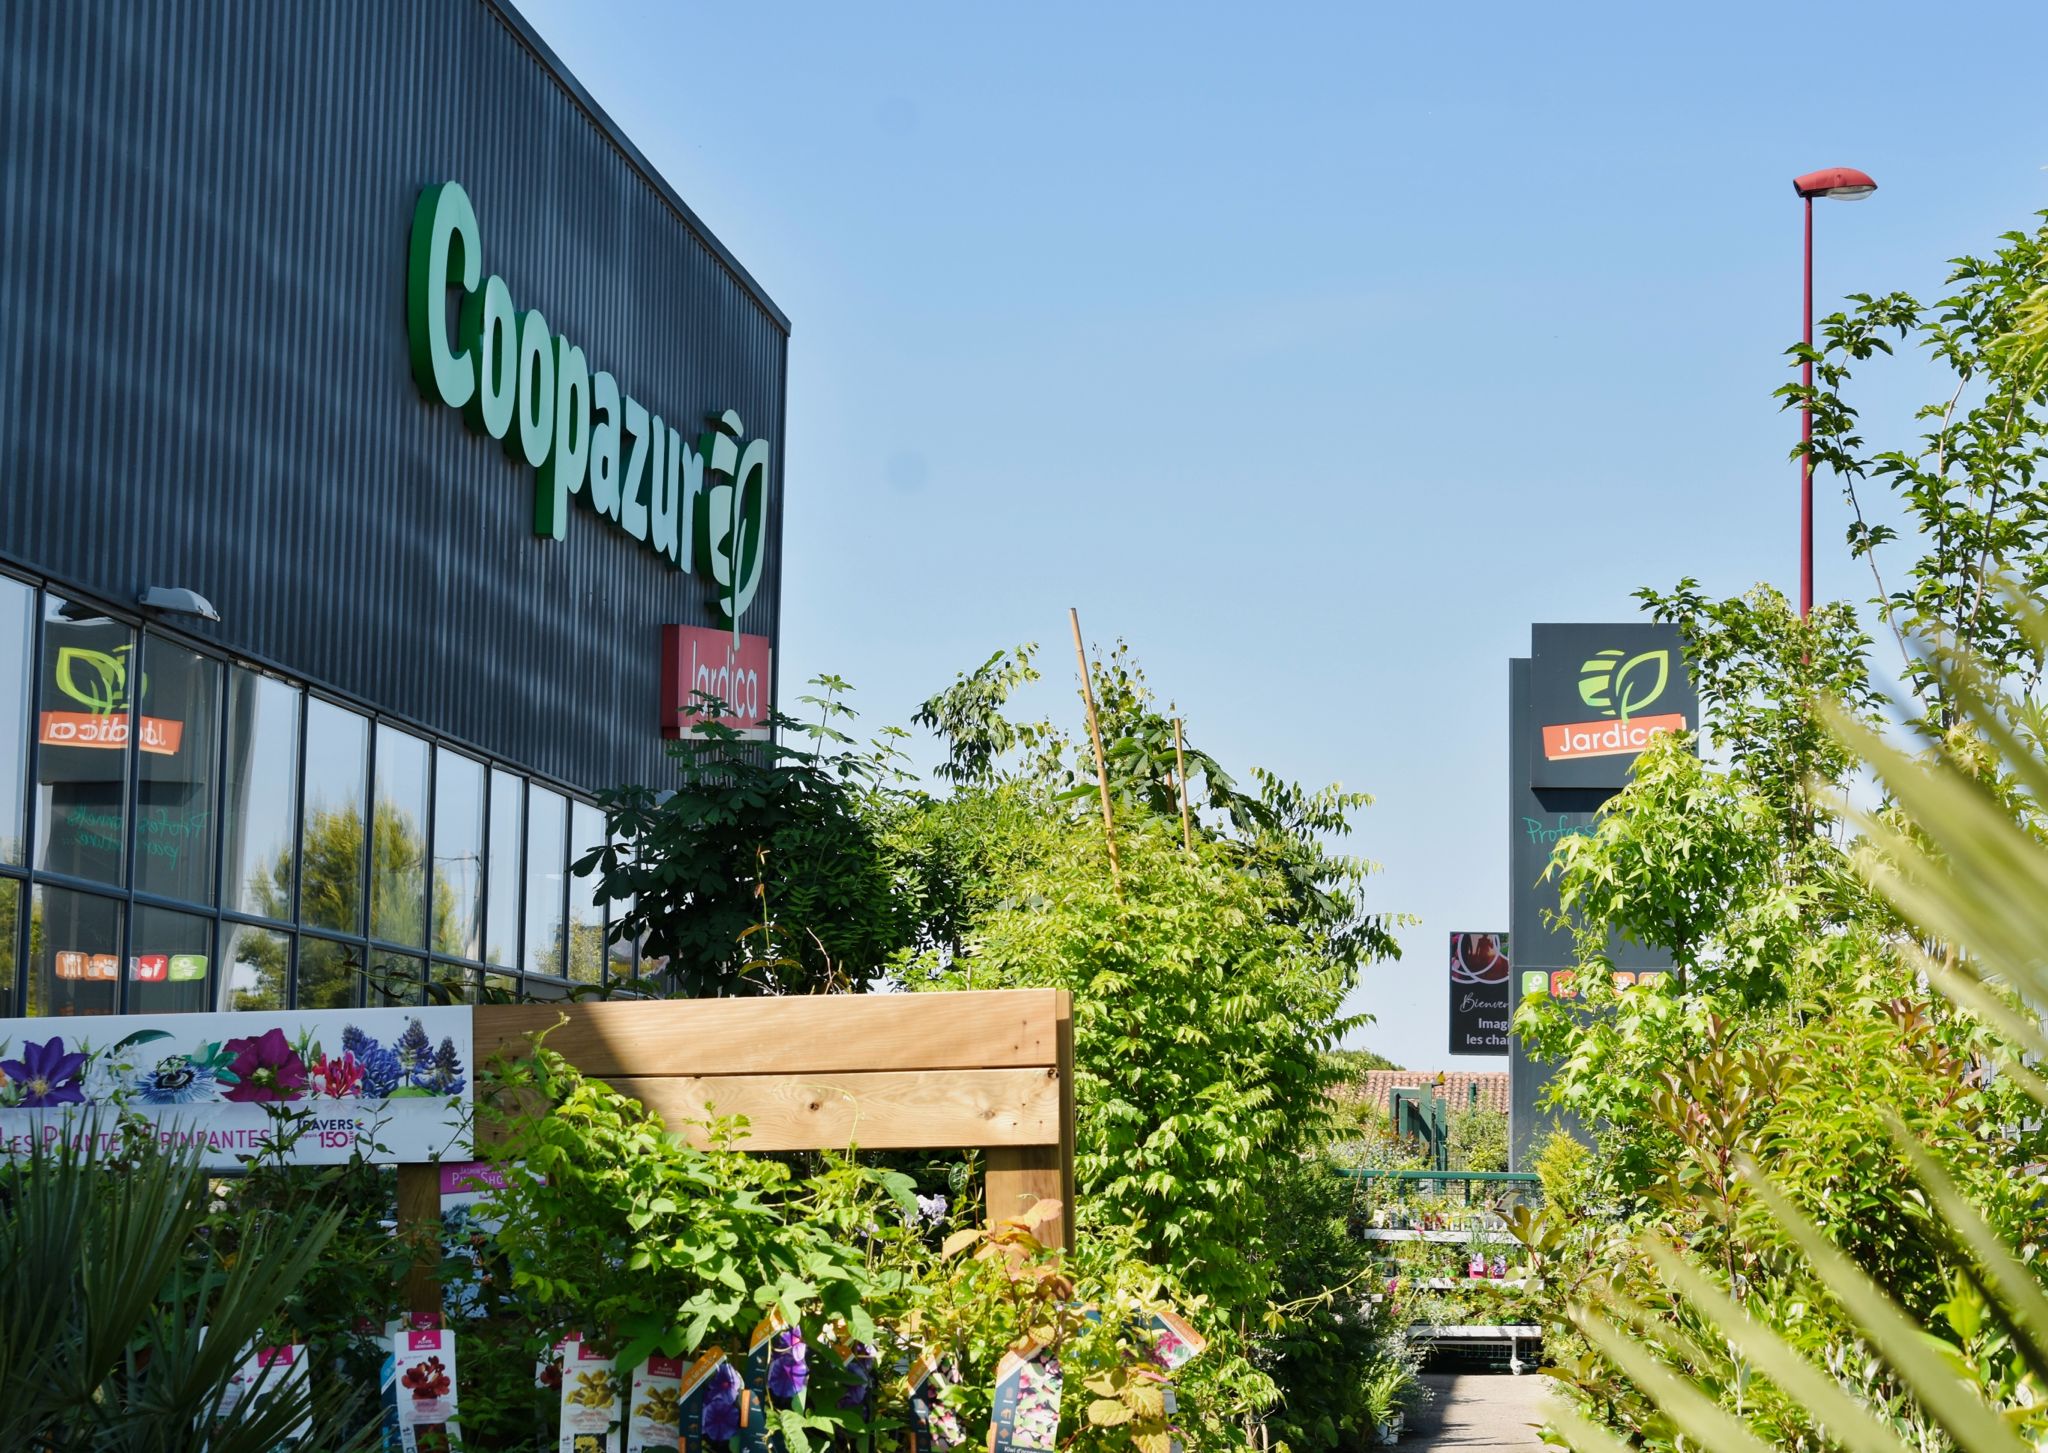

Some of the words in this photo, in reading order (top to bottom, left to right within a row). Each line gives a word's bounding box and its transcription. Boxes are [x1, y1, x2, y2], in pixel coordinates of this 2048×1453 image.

[411, 180, 704, 574] Coopazur
[687, 639, 758, 718] Jardica
[1521, 815, 1597, 845] Profess
[1479, 1017, 1510, 1031] Imag
[1466, 1034, 1484, 1045] les
[44, 1125, 121, 1153] PANTE
[318, 1131, 349, 1148] 150
